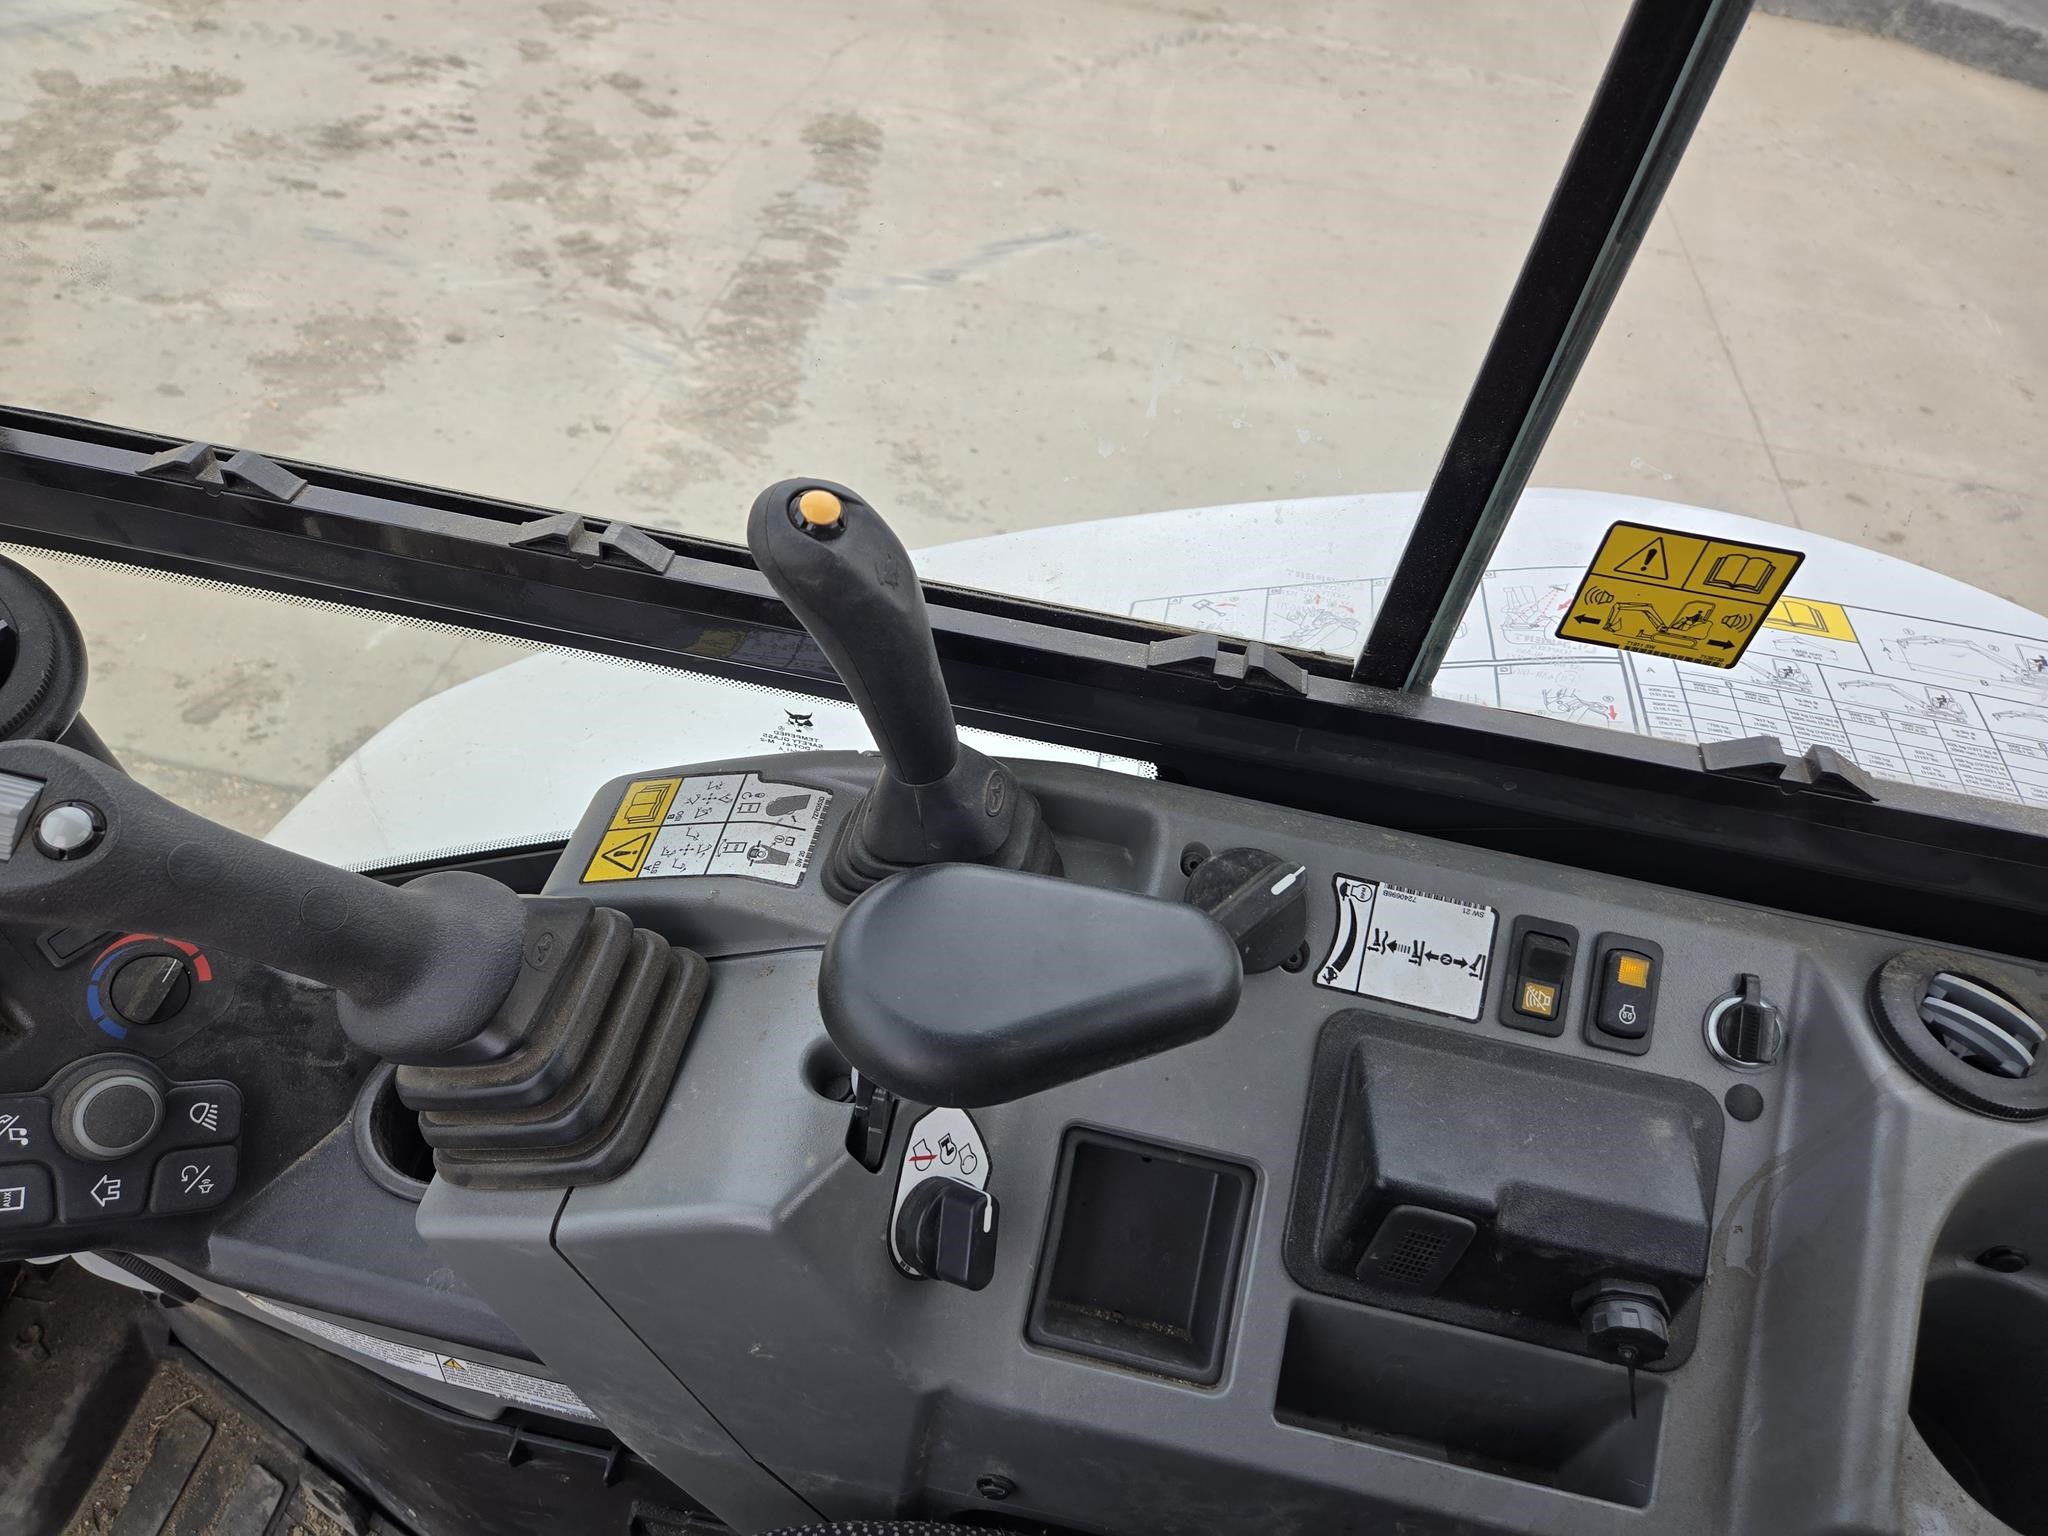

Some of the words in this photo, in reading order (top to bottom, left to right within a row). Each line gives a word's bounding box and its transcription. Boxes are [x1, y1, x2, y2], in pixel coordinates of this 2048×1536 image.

[650, 860, 662, 874] STD
[1471, 910, 1485, 919] SW
[3, 1191, 12, 1207] AUX
